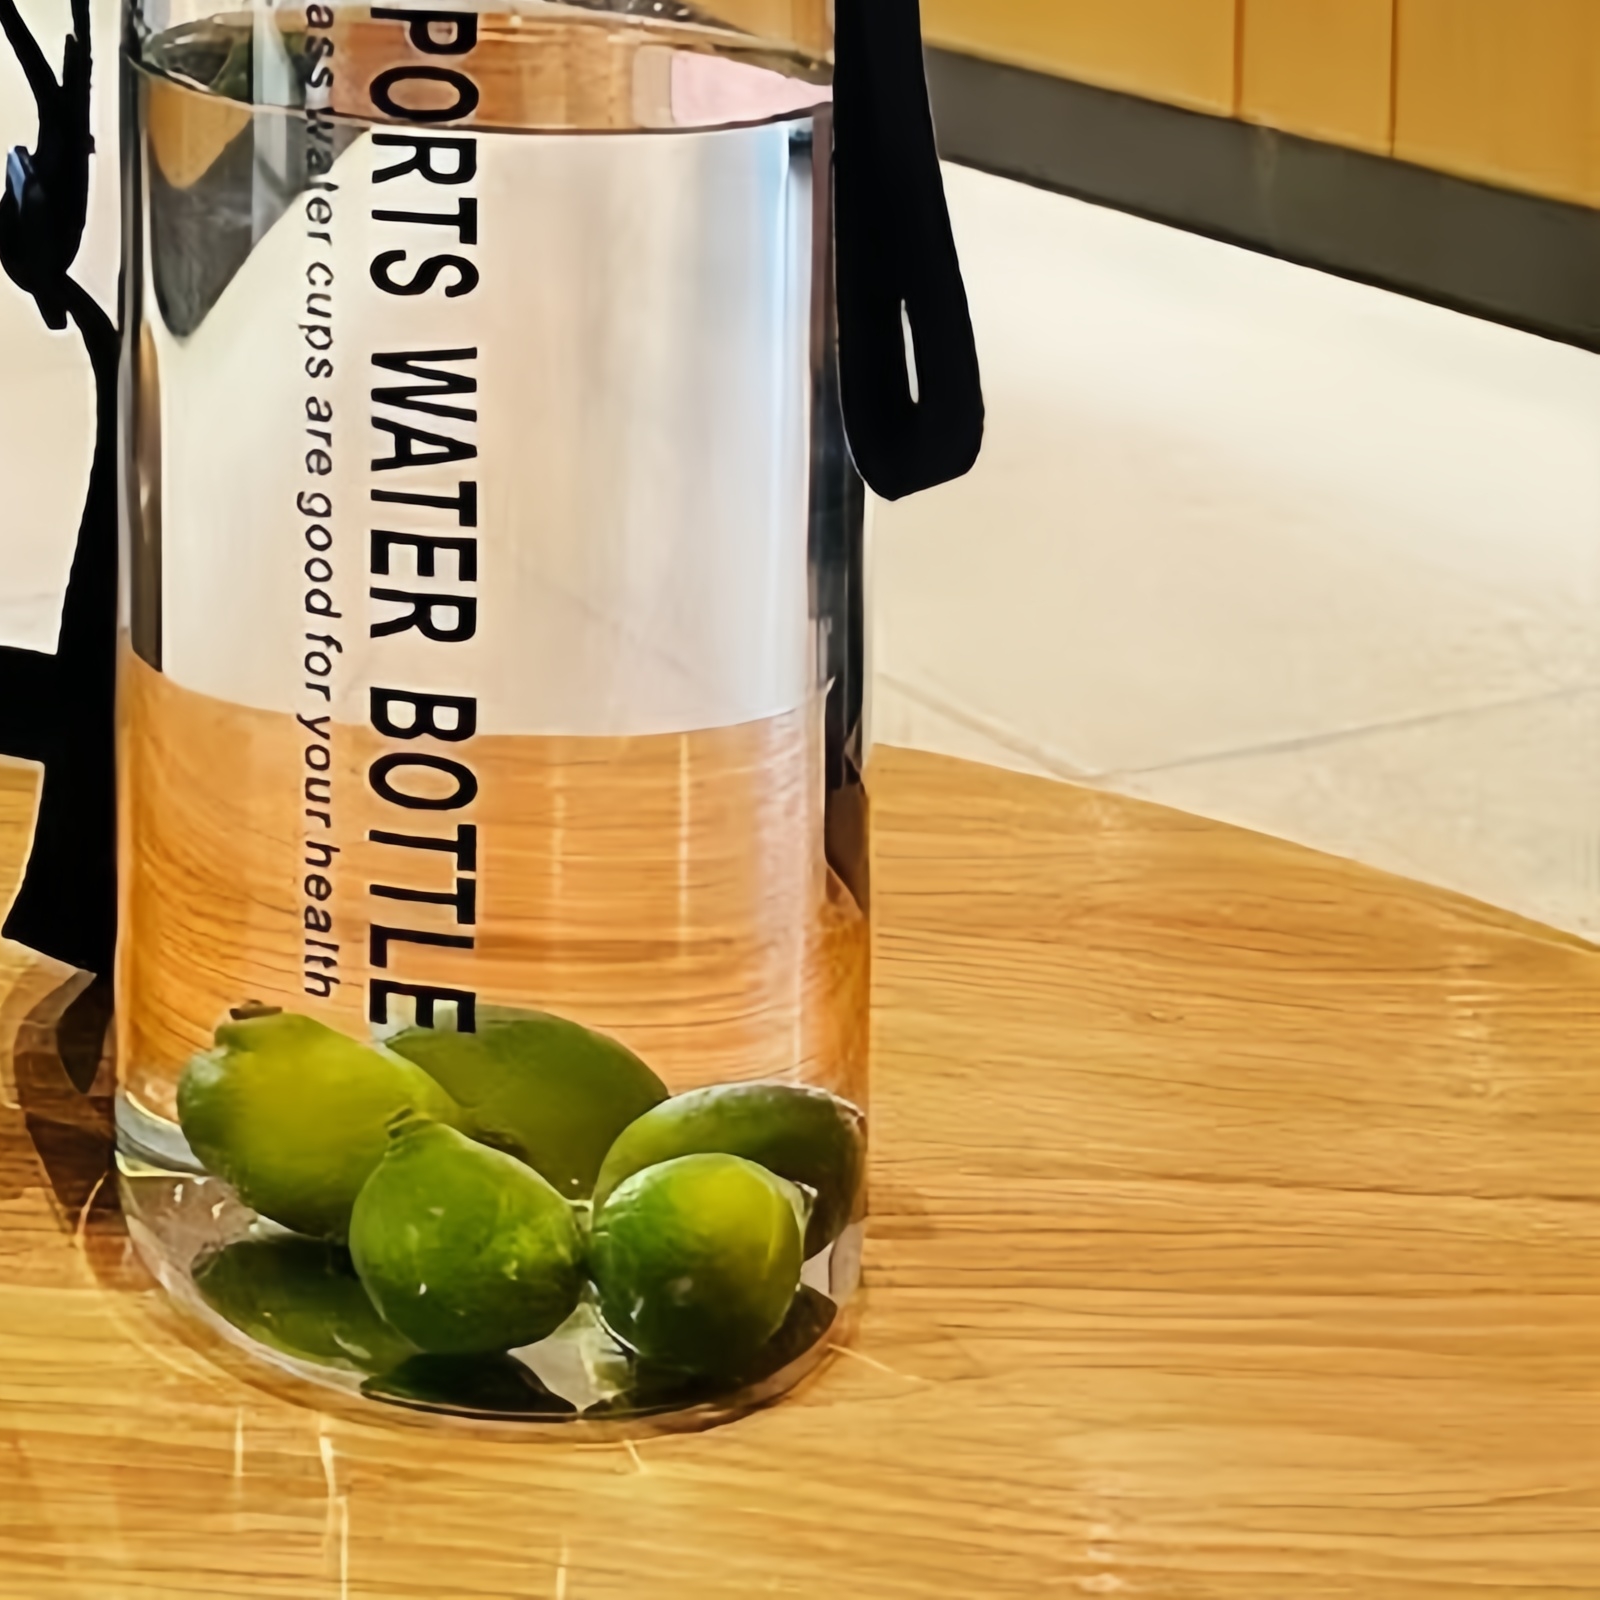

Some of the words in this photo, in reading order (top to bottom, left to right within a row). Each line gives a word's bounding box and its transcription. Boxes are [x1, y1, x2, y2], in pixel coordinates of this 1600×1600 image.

[304, 106, 340, 246] water
[297, 261, 334, 379] cups
[304, 397, 334, 477] are
[370, 347, 478, 643] WATER
[296, 491, 342, 619] good
[303, 632, 343, 702] for
[295, 713, 332, 828] your
[303, 842, 341, 999] health
[368, 686, 478, 1034] BOTTLE
